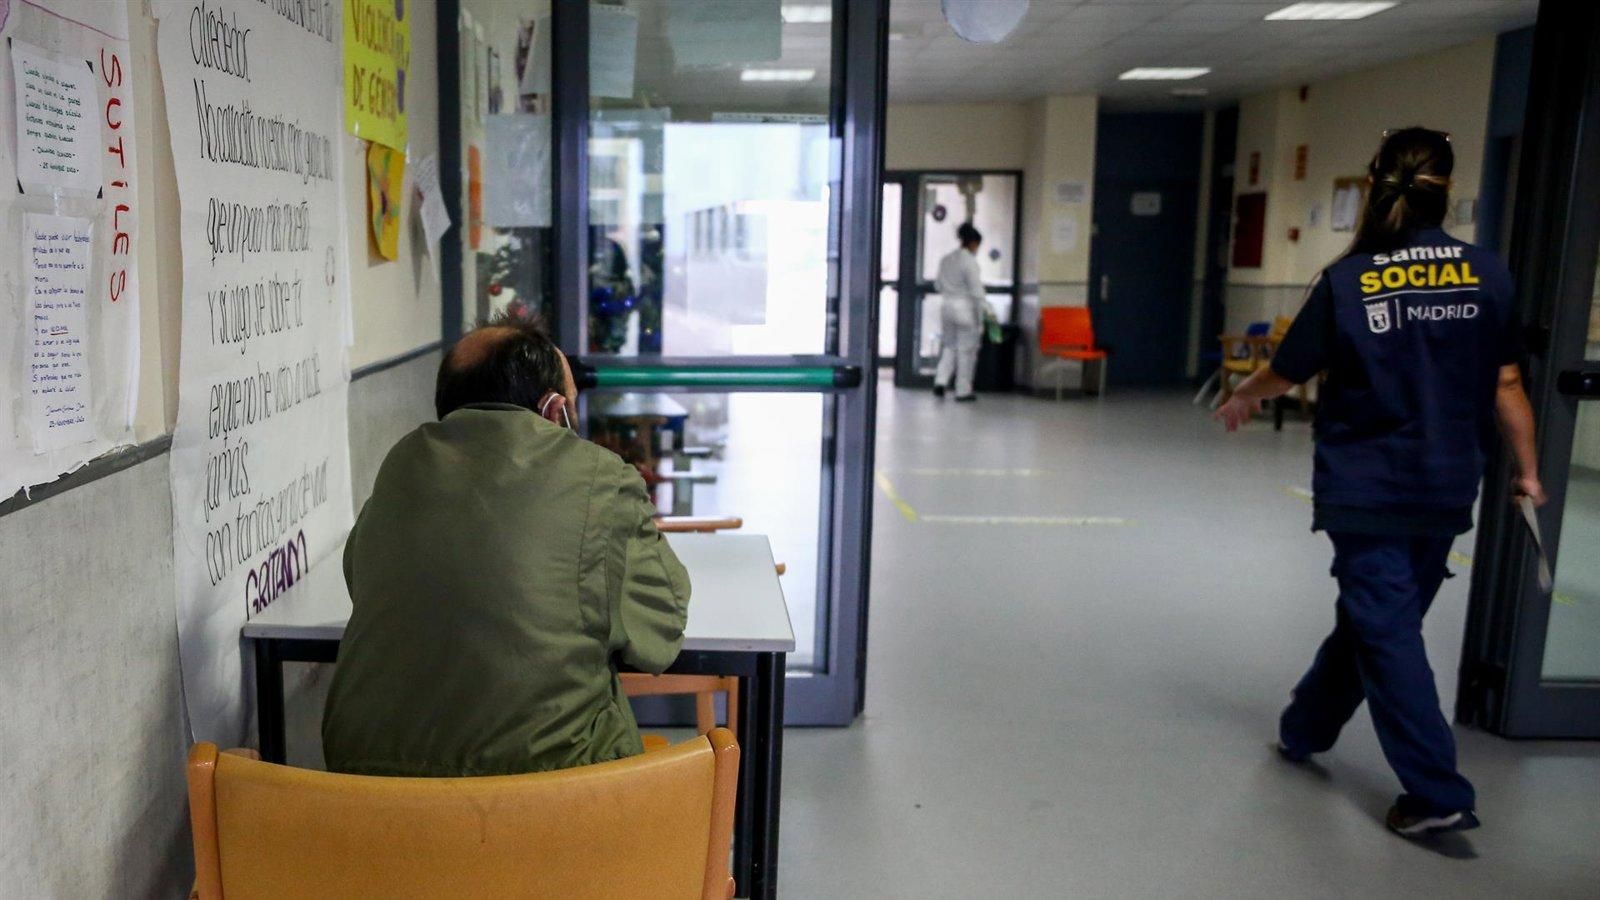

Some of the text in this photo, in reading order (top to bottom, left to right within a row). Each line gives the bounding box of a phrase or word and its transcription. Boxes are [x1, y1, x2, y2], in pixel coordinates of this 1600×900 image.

[1373, 245, 1463, 266] samur
[1360, 263, 1480, 294] SOCIAL
[1407, 303, 1480, 322] MADRID
[205, 521, 233, 587] con
